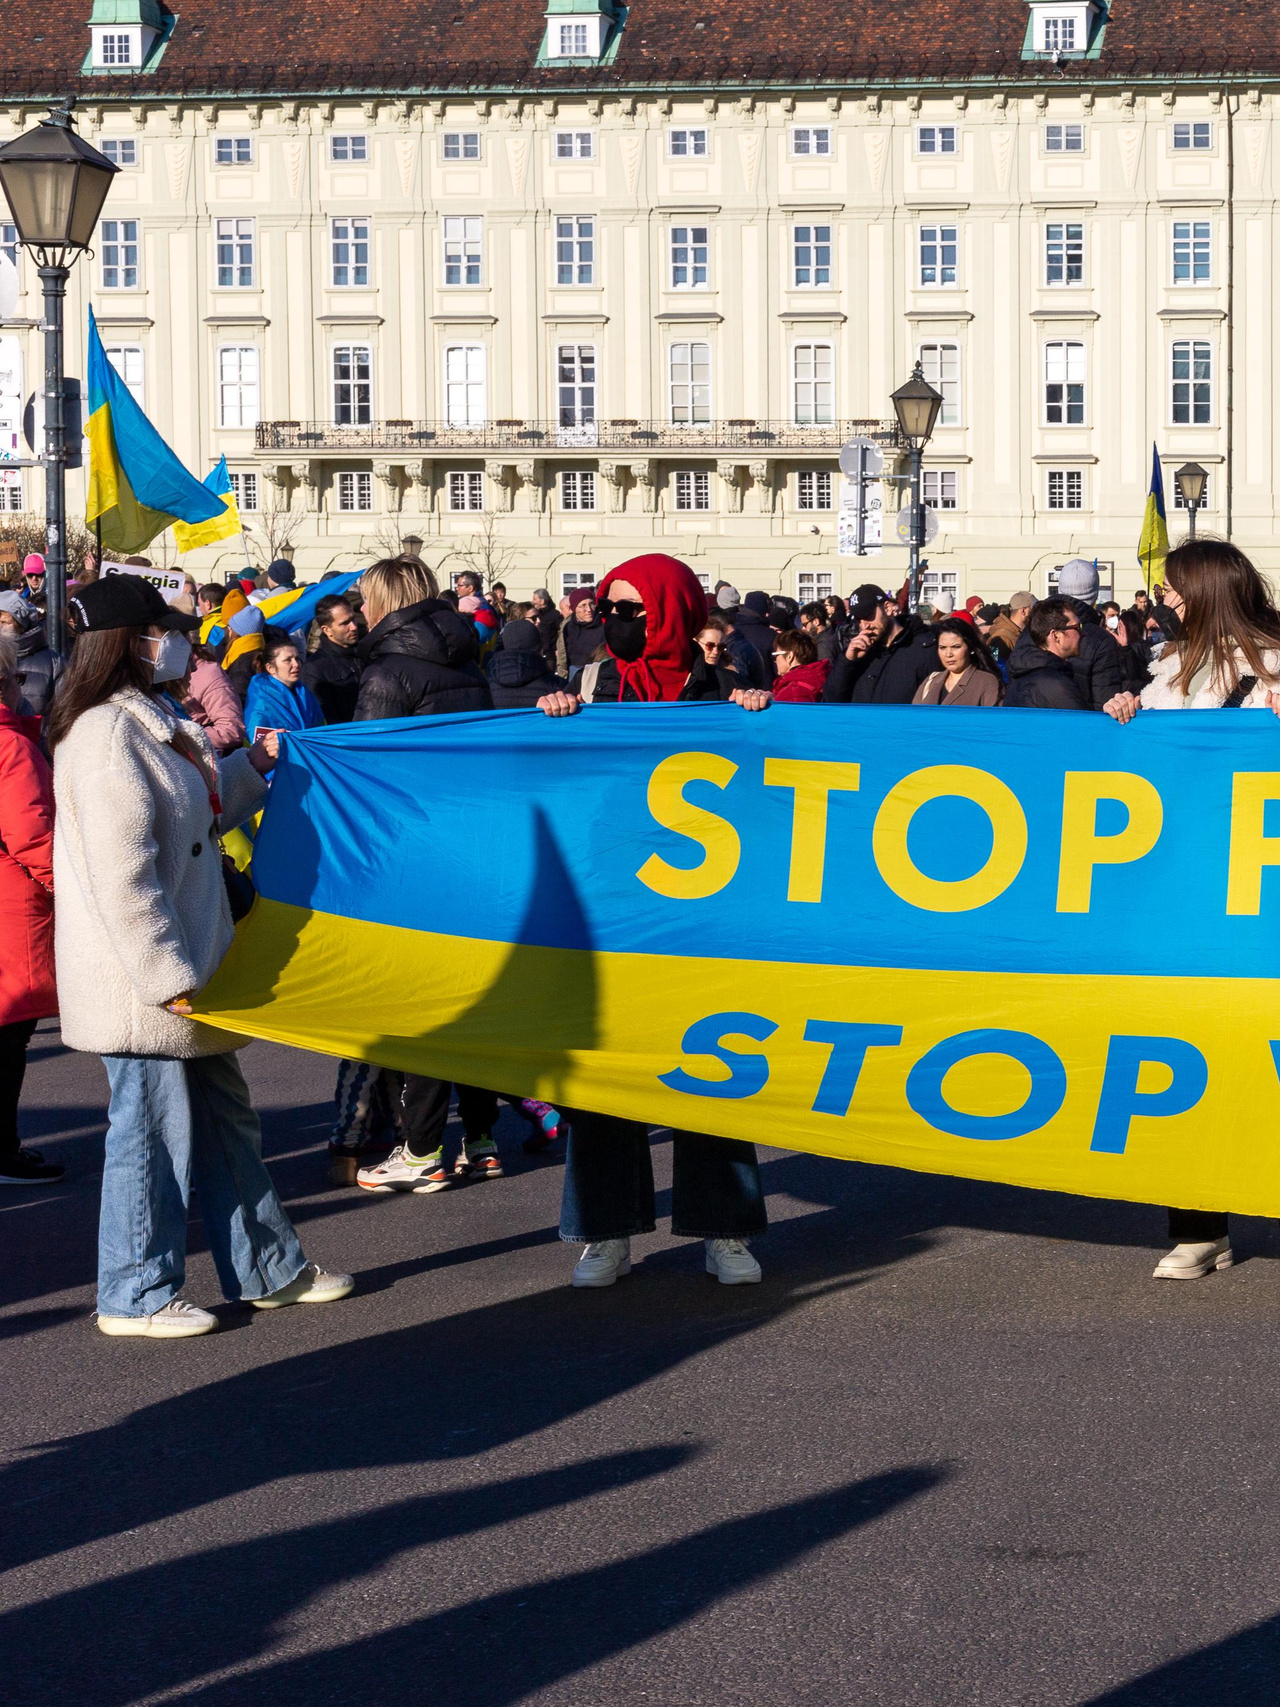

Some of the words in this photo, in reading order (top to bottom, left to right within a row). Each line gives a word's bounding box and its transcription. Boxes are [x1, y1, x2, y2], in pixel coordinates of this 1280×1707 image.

[105, 567, 180, 589] Grgia
[636, 752, 1163, 914] STOP
[658, 1012, 1208, 1155] STOP
